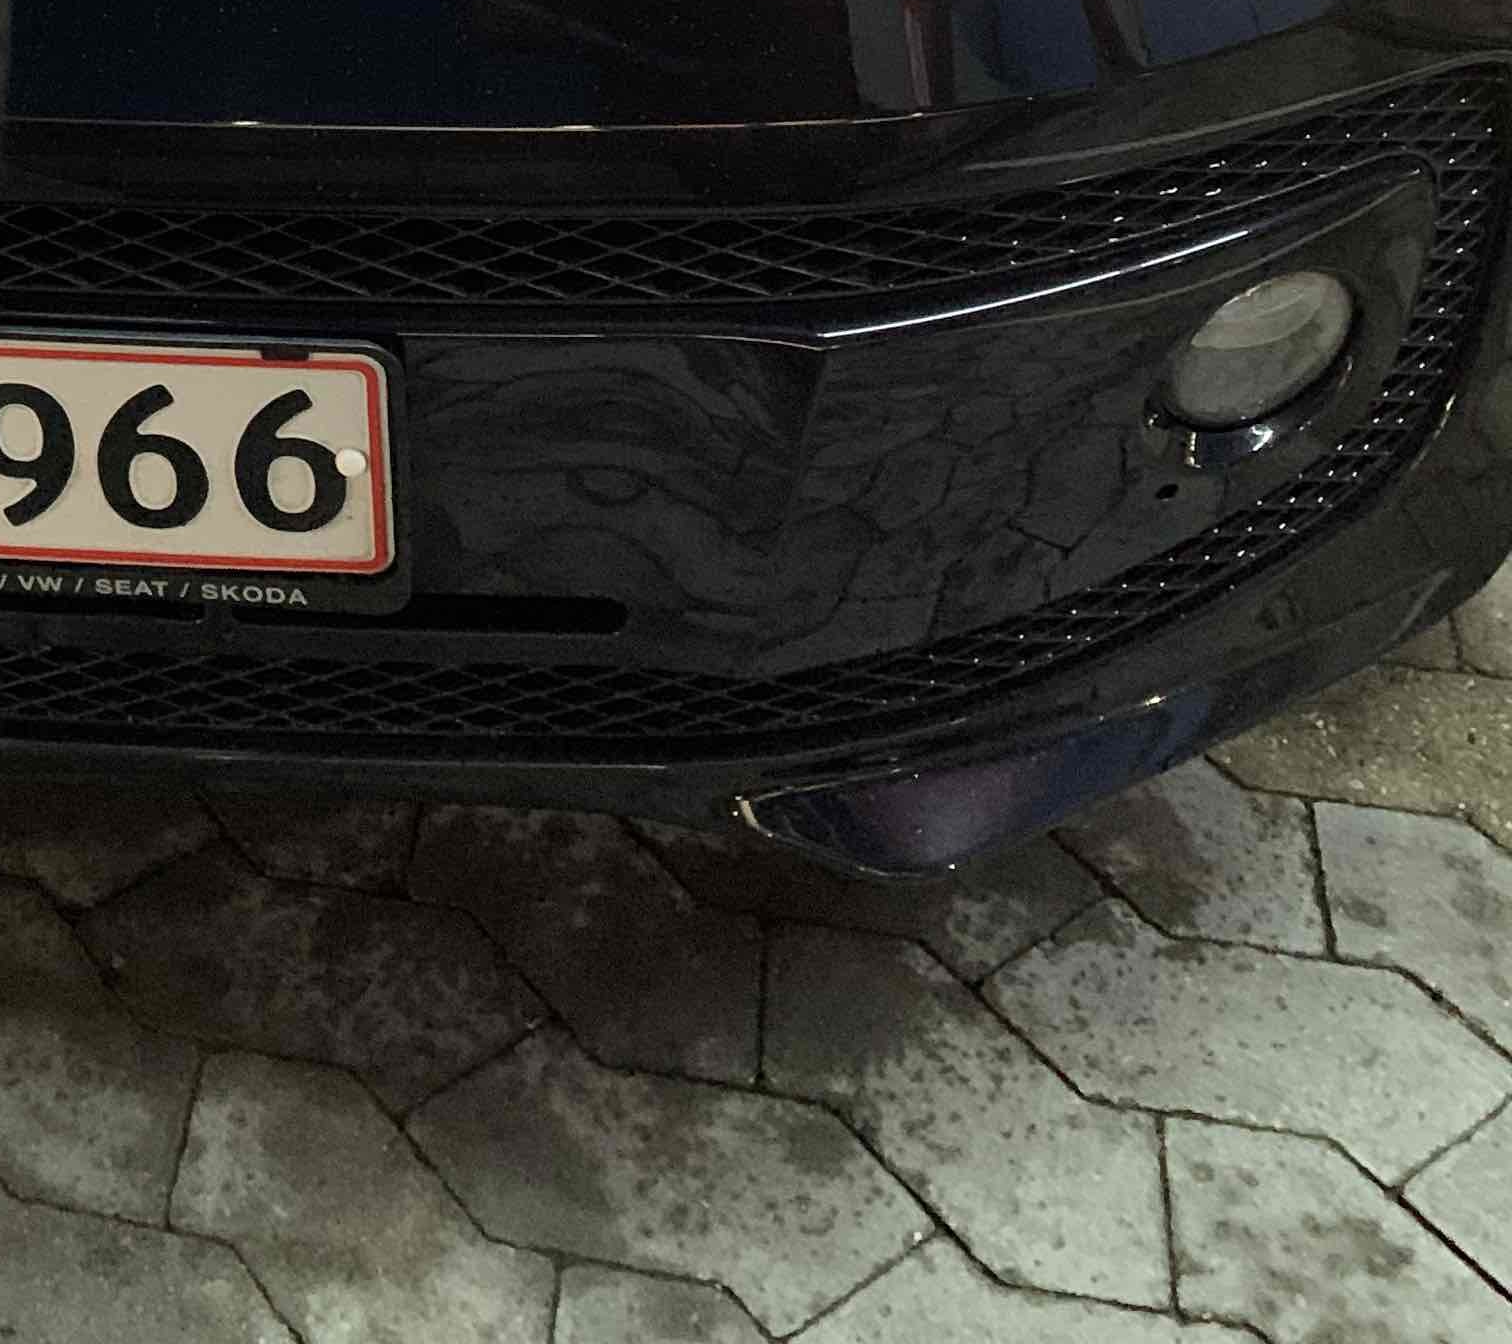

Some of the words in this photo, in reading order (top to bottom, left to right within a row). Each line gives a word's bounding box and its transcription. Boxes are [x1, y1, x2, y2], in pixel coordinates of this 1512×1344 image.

[17, 575, 63, 593] VW
[94, 578, 169, 598] SEAT
[200, 583, 309, 606] SKODA
